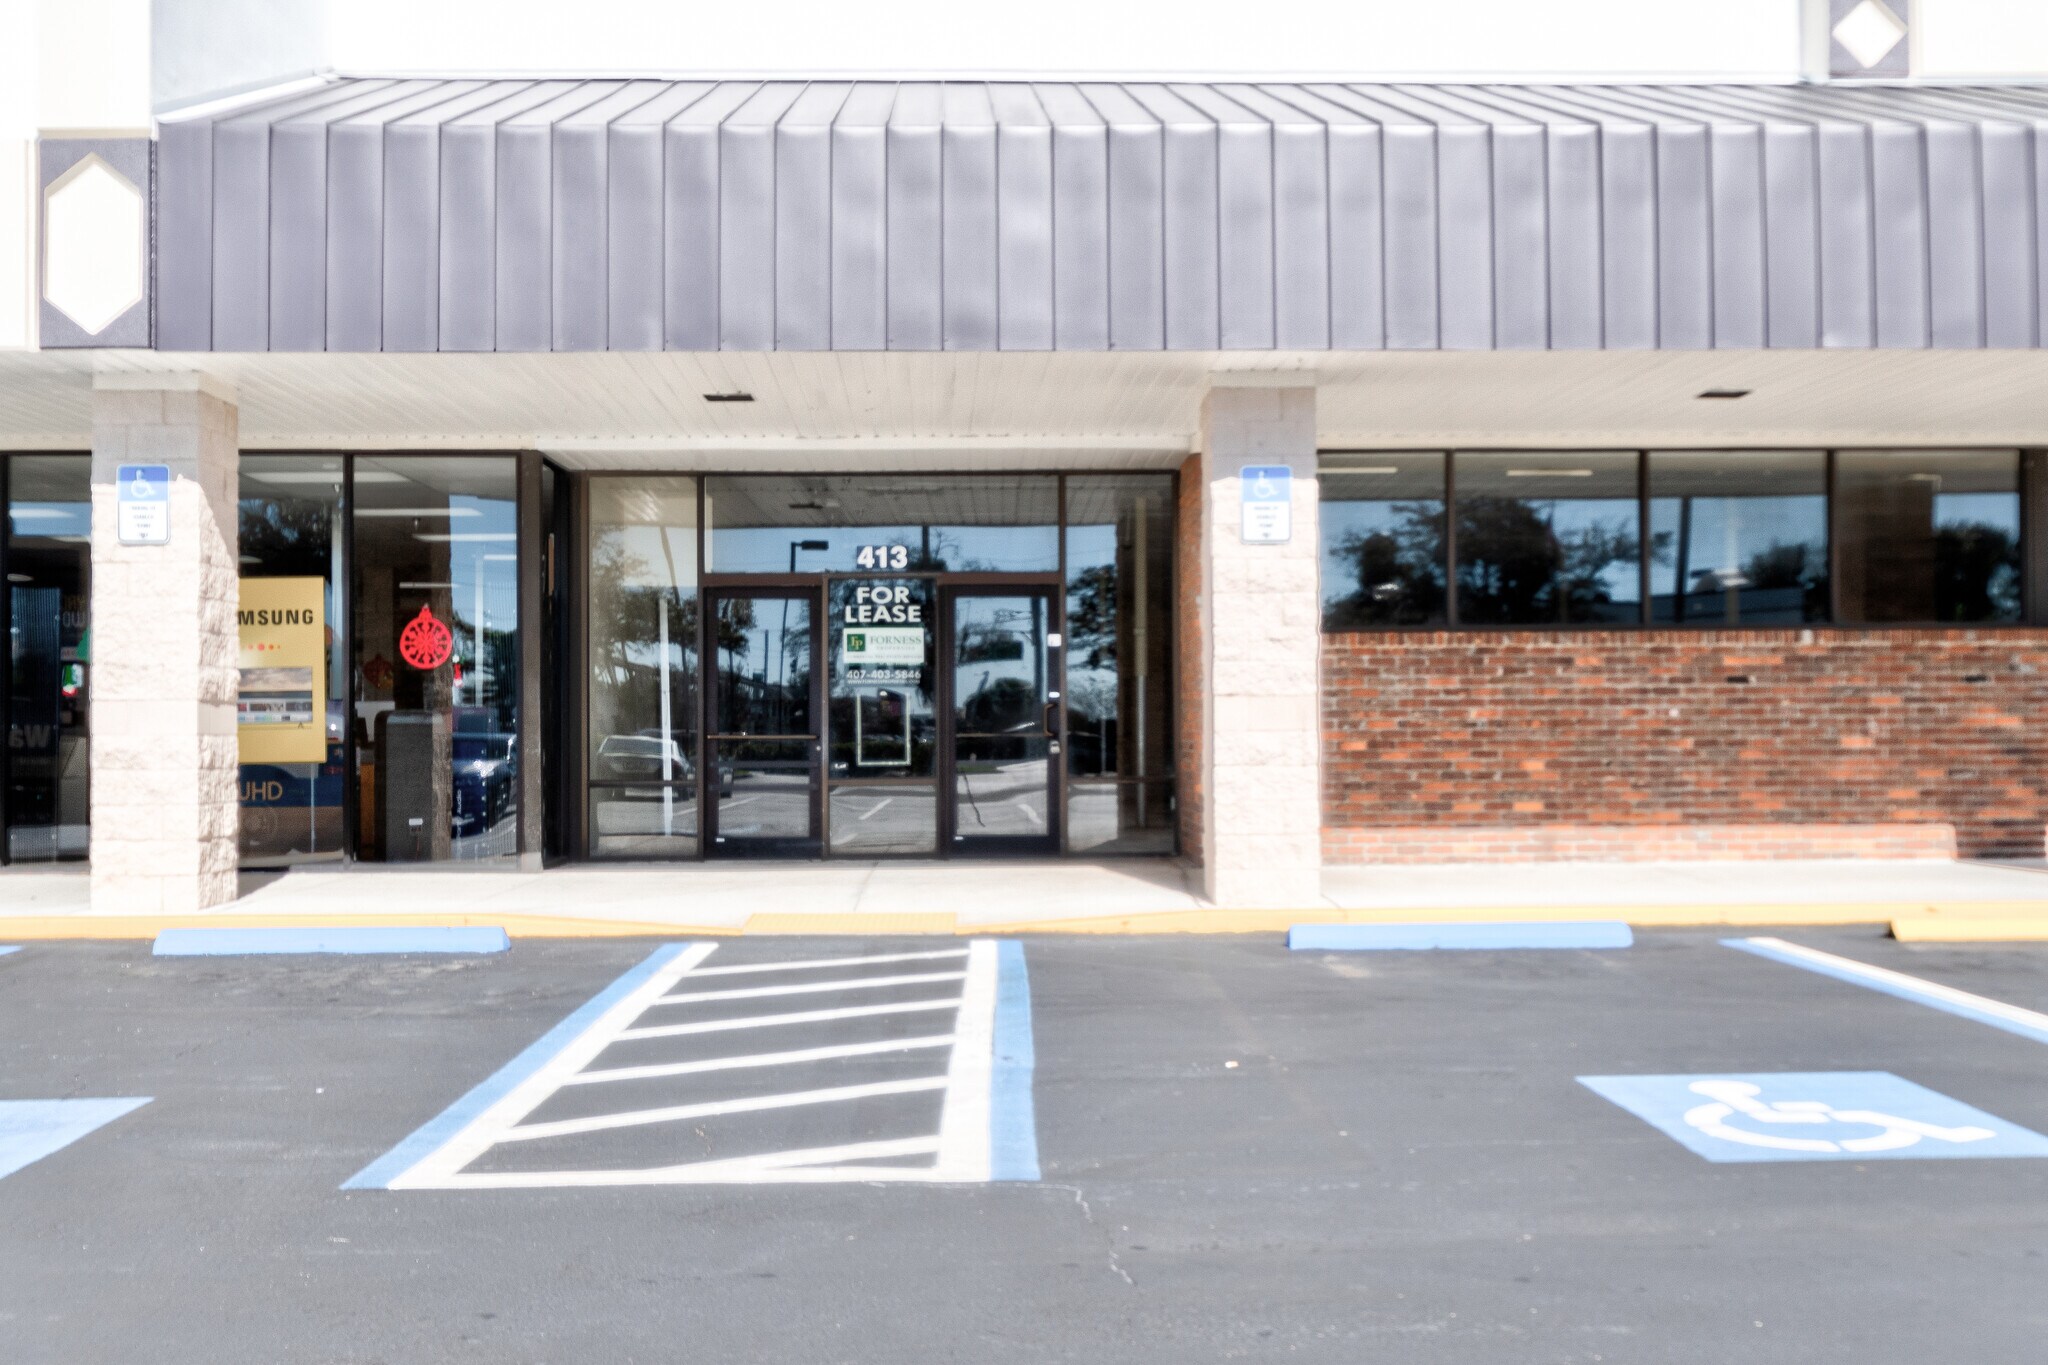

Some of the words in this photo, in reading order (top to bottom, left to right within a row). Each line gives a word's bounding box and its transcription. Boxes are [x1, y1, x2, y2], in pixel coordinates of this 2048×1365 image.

[857, 545, 908, 569] 413
[856, 586, 910, 604] FOR
[238, 609, 314, 626] MSUNG
[845, 605, 922, 623] LEASE
[870, 635, 922, 645] FORNESS
[846, 669, 922, 679] 407-403-5846
